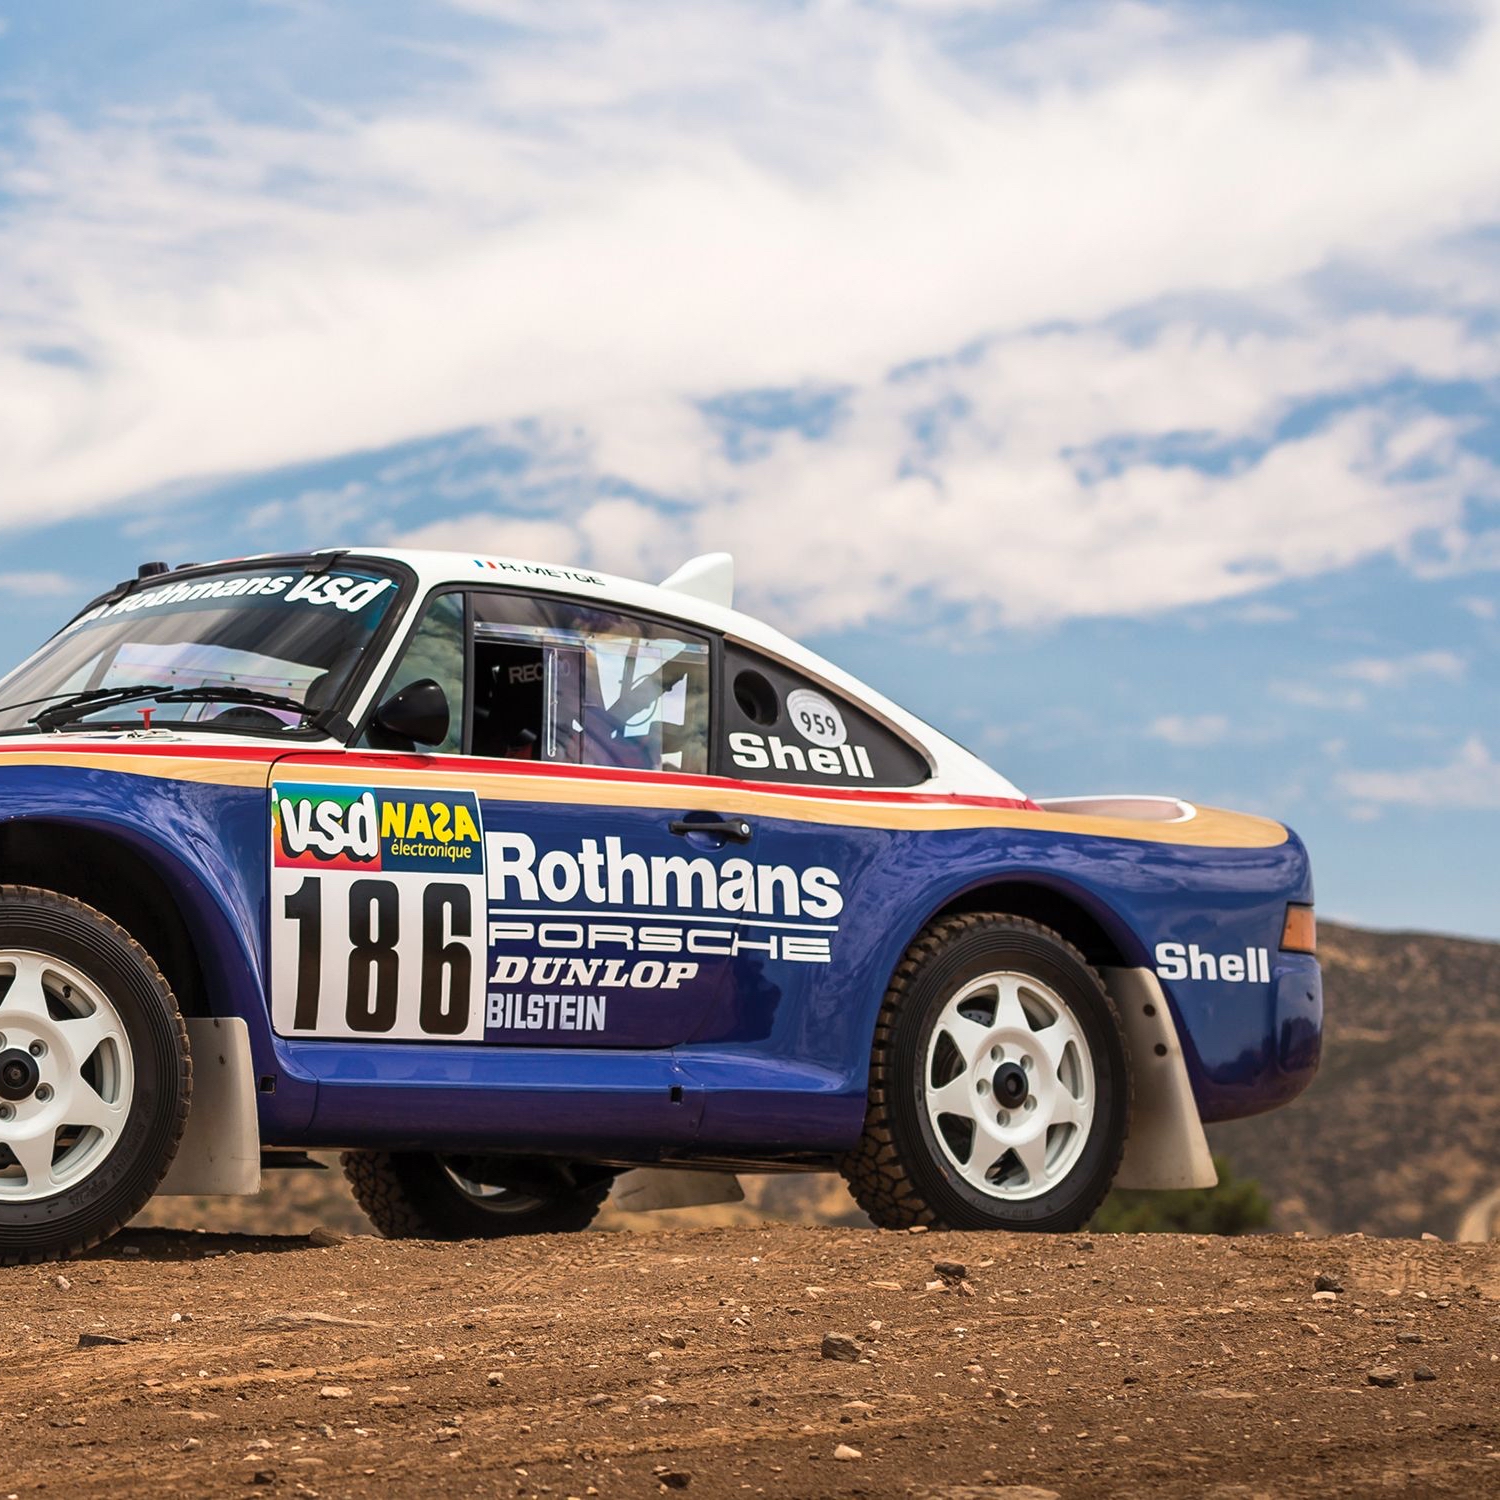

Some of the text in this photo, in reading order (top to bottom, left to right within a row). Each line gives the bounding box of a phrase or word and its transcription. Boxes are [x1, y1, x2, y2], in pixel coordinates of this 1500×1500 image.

[524, 565, 606, 586] METGE
[508, 658, 571, 684] RECO
[800, 711, 836, 736] 959
[728, 731, 875, 779] Shell
[391, 838, 473, 863] électronique
[487, 830, 844, 920] Rothmans
[283, 876, 473, 1036] 186
[488, 921, 832, 963] PORSCHE
[489, 955, 699, 990] DUNLOP
[1155, 942, 1271, 983] Shell
[485, 992, 606, 1032] BILSTEIN
